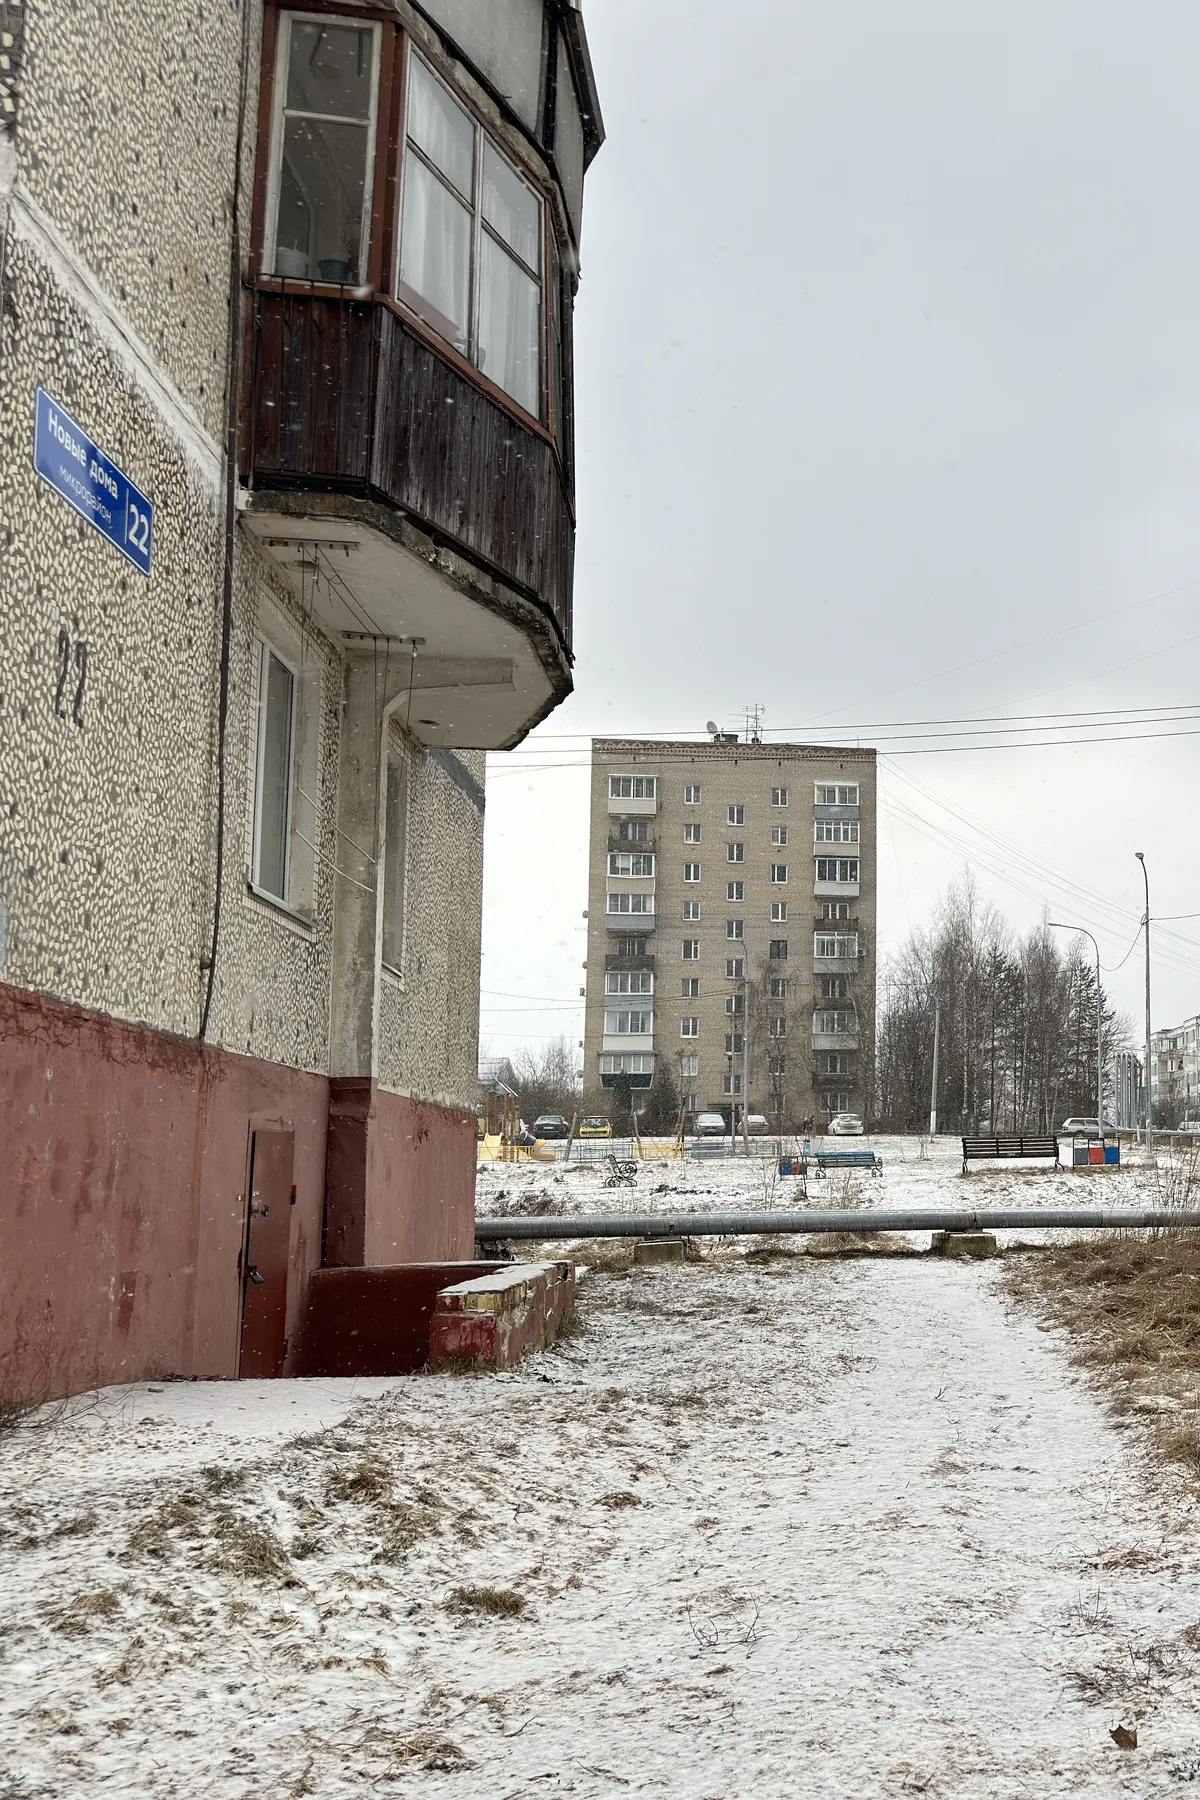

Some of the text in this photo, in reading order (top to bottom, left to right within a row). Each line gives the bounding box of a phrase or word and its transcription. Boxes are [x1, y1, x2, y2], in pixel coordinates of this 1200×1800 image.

[48, 408, 119, 499] Новые дома
[60, 465, 112, 524] микрорайон
[129, 504, 149, 556] 22
[55, 629, 88, 729] 22
